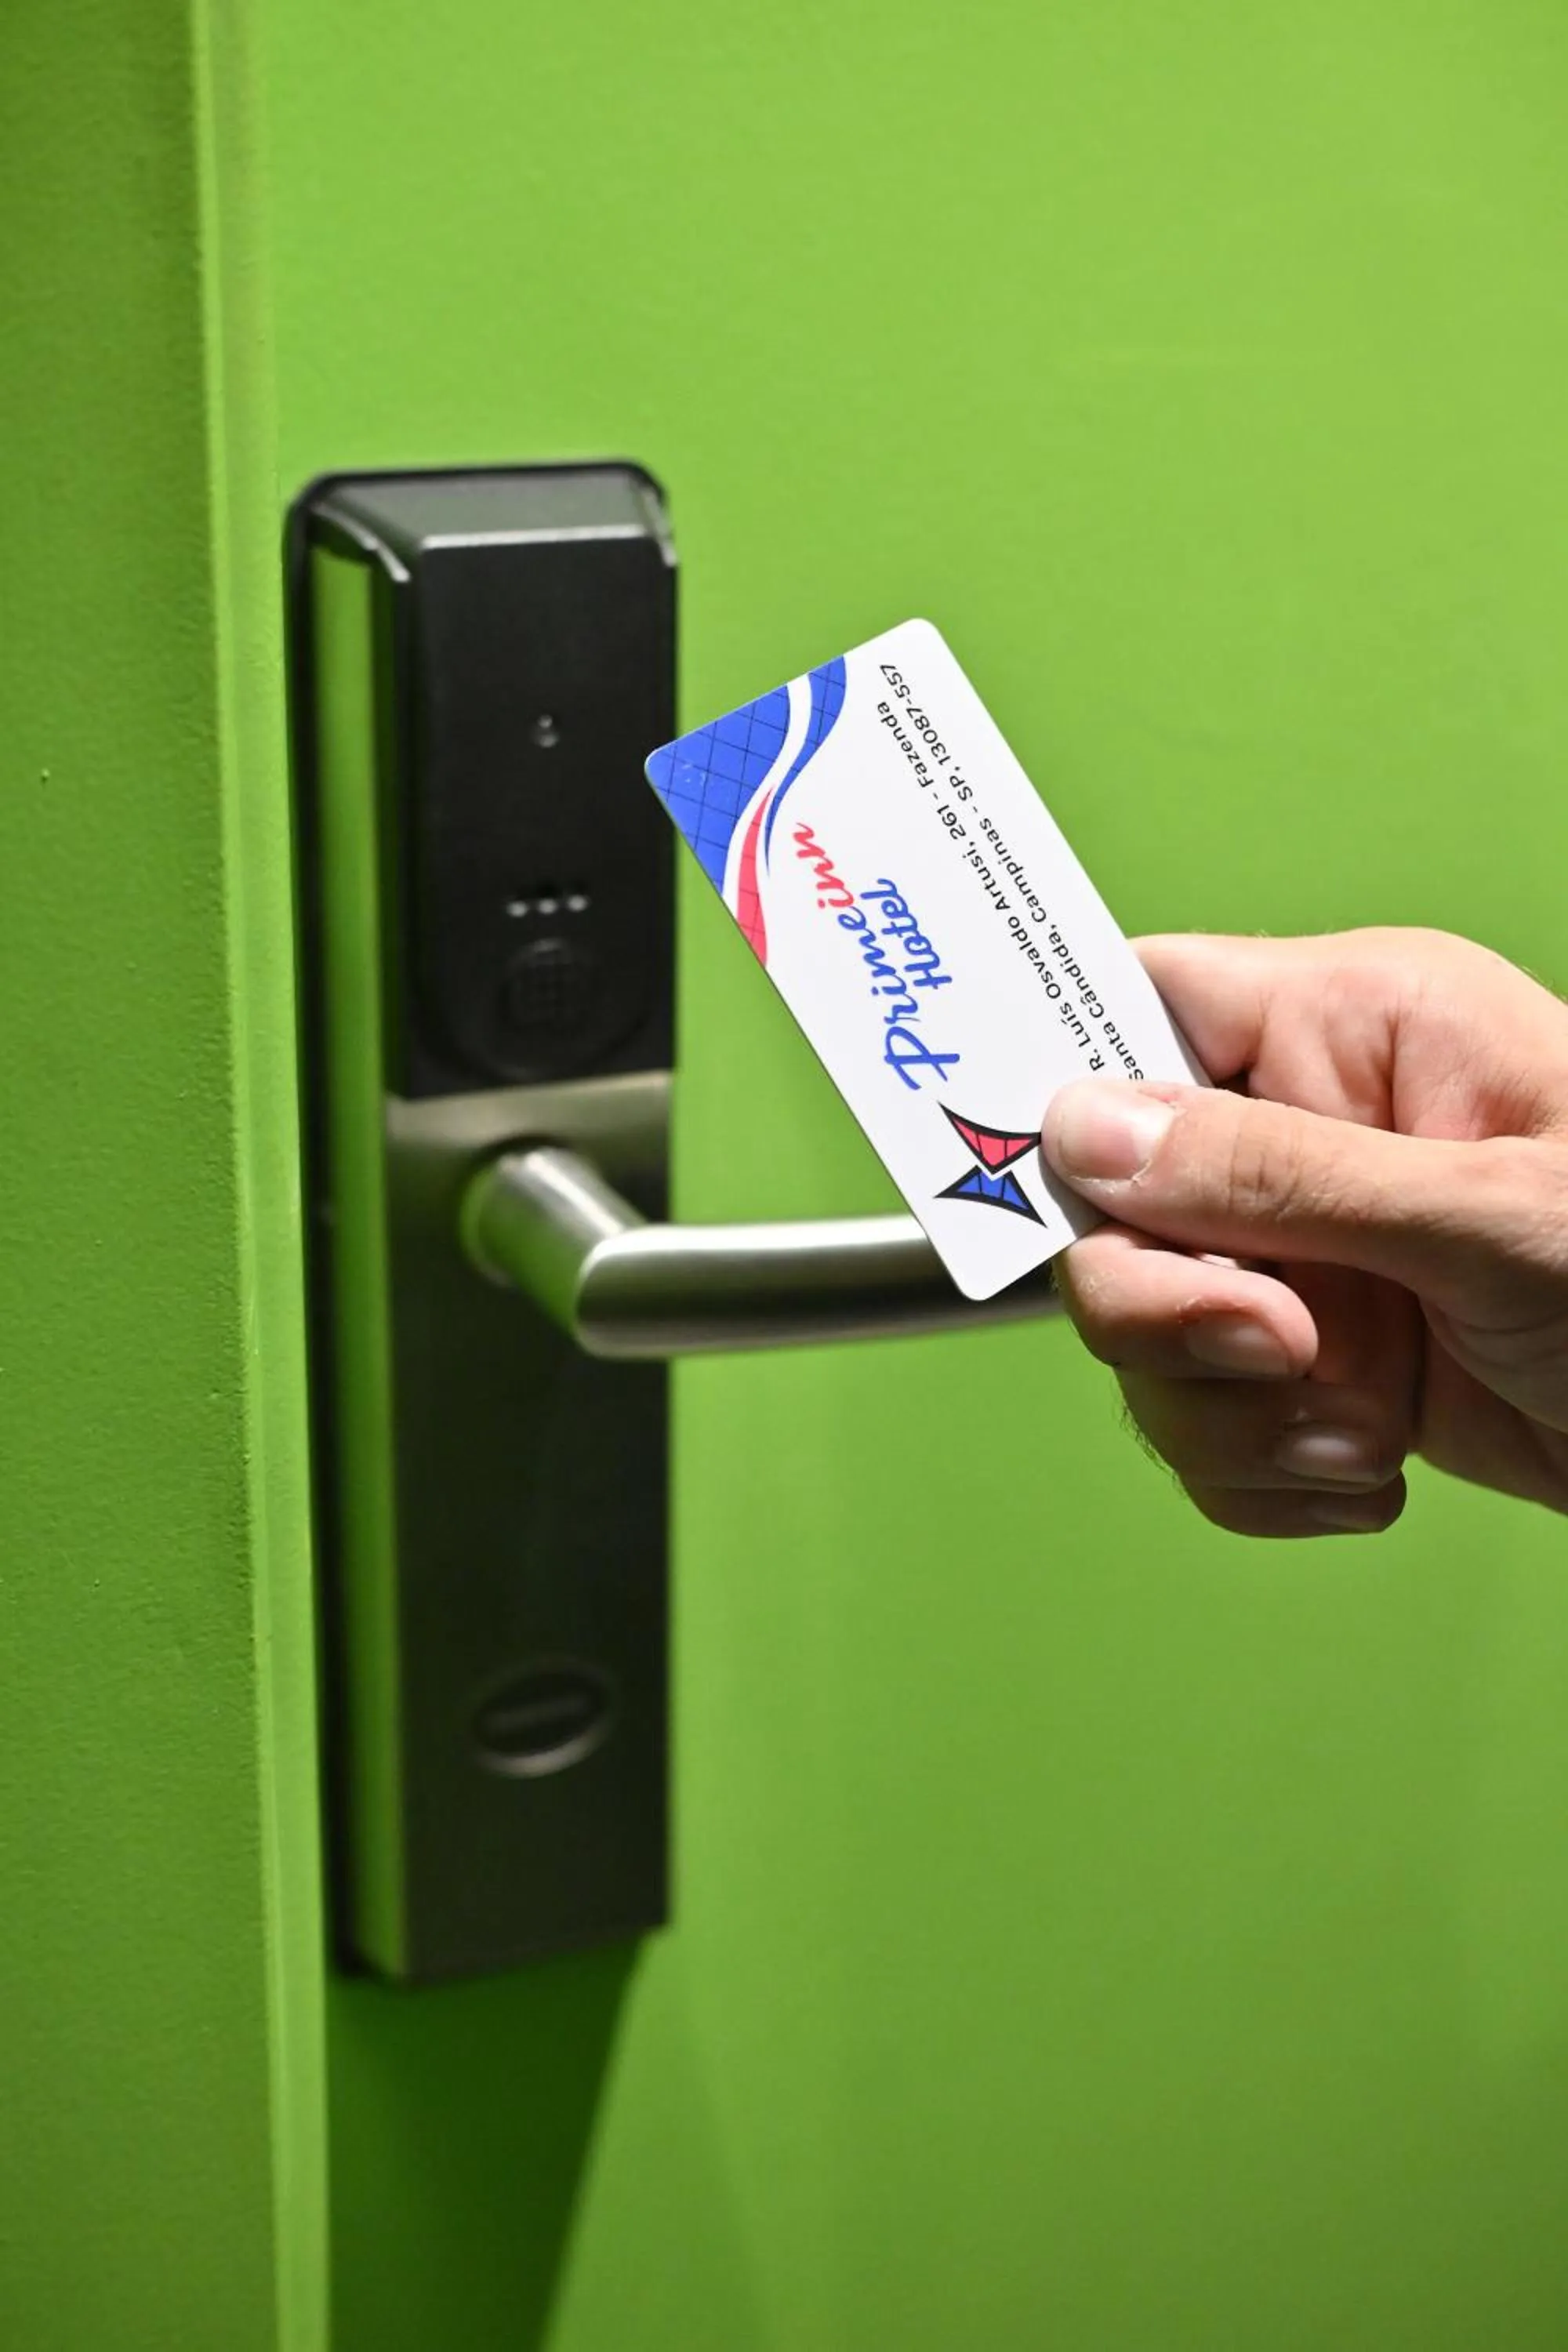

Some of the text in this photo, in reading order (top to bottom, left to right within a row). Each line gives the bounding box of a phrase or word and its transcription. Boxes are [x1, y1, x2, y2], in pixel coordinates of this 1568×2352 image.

[877, 701, 934, 788] Fazenda
[879, 663, 951, 765] 13087-557
[937, 804, 967, 840] 261
[962, 840, 1011, 911] Artusi,
[979, 817, 1047, 923] Campinas
[859, 877, 953, 990] Hotel
[1007, 916, 1062, 1000] Osvaldo
[1048, 924, 1105, 1018] Cândida,
[1059, 1001, 1091, 1048] Luís
[1089, 1048, 1105, 1072] R.
